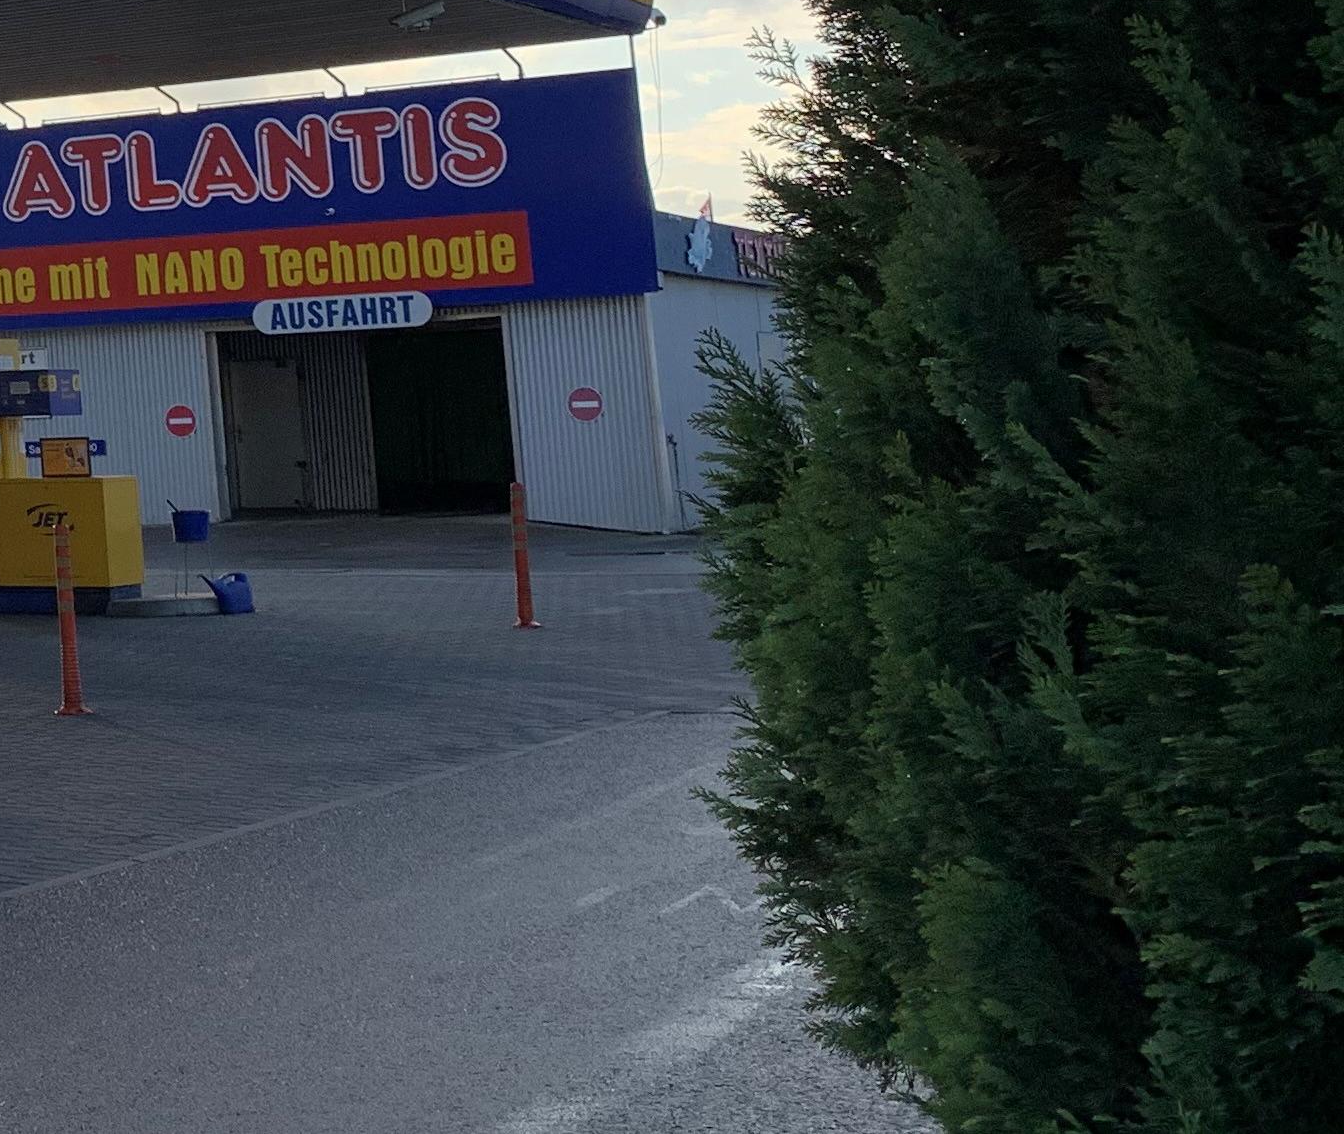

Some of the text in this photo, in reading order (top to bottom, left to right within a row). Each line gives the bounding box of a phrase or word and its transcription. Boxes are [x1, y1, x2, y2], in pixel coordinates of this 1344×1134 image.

[2, 97, 508, 223] ATLANTIS
[49, 256, 110, 301] mit
[134, 246, 246, 297] NANO
[259, 228, 517, 288] Technologie
[269, 293, 416, 332] AUSFAHRT
